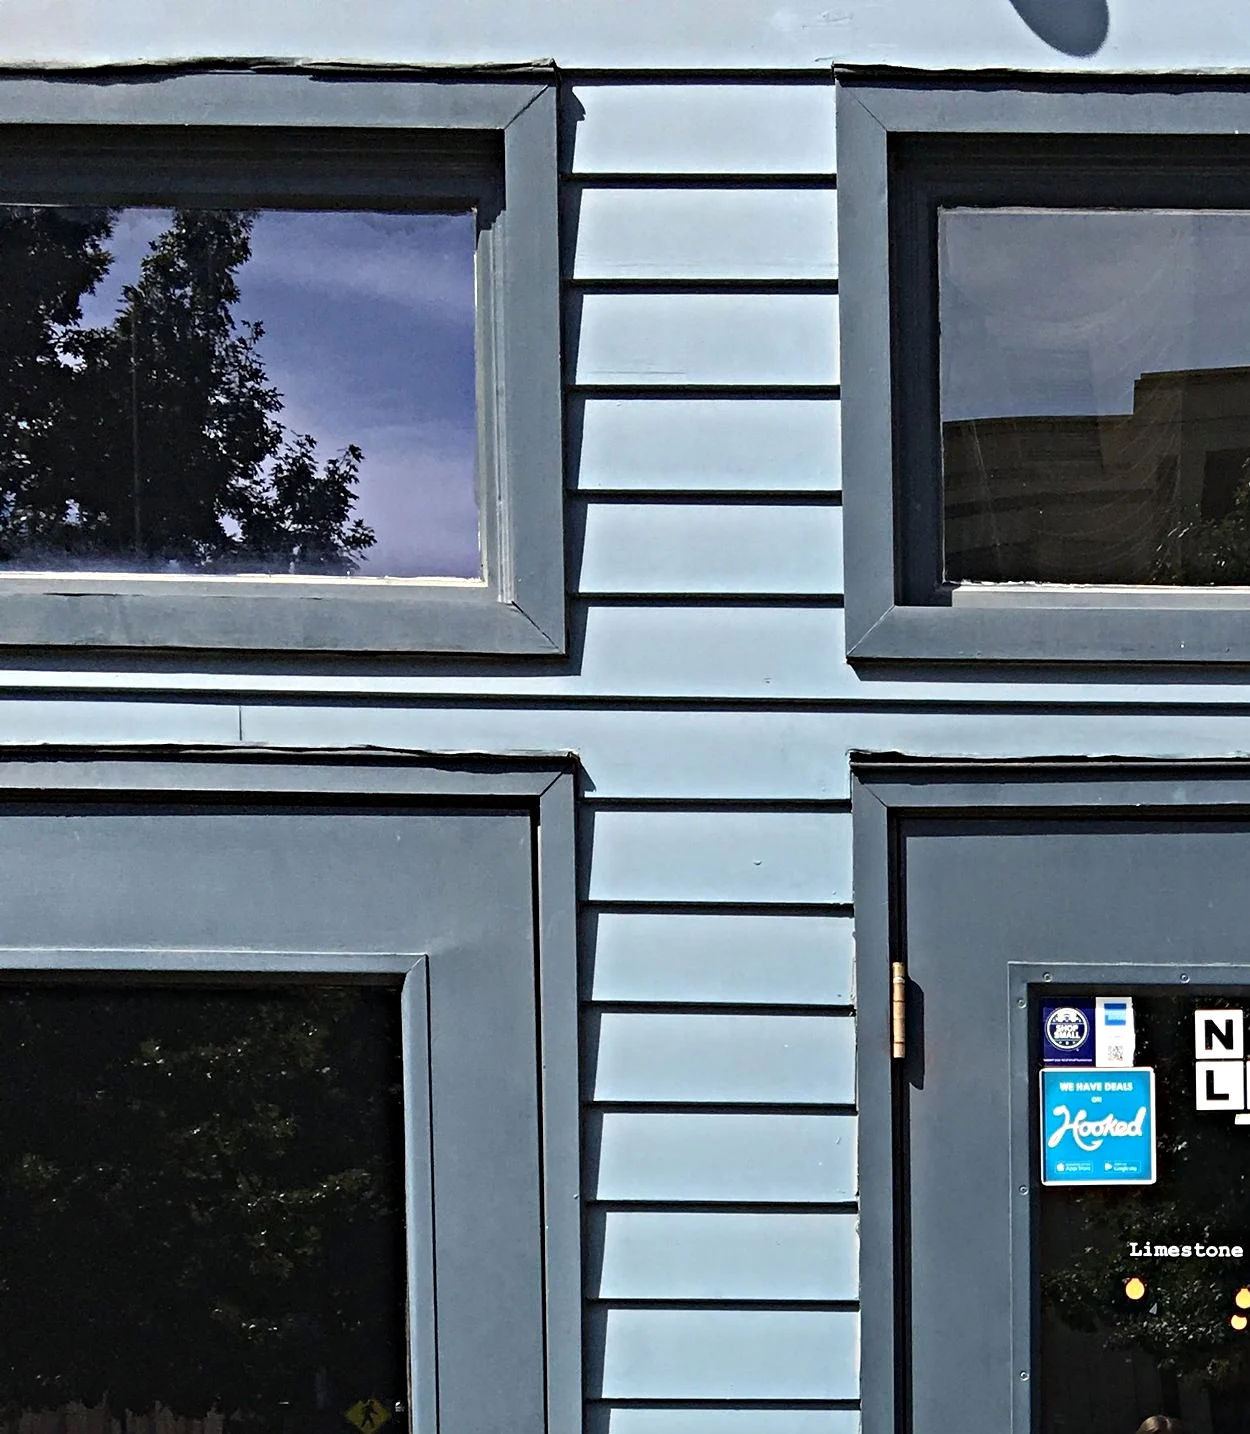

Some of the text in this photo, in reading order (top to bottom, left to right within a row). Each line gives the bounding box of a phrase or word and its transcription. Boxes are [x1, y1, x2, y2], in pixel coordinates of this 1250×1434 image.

[1056, 1024, 1079, 1032] SHOP
[1204, 1019, 1234, 1050] N
[1059, 1082, 1133, 1092] WE HAVE DEALS
[1048, 1104, 1147, 1151] Hooked
[1129, 1242, 1244, 1258] Limestone
